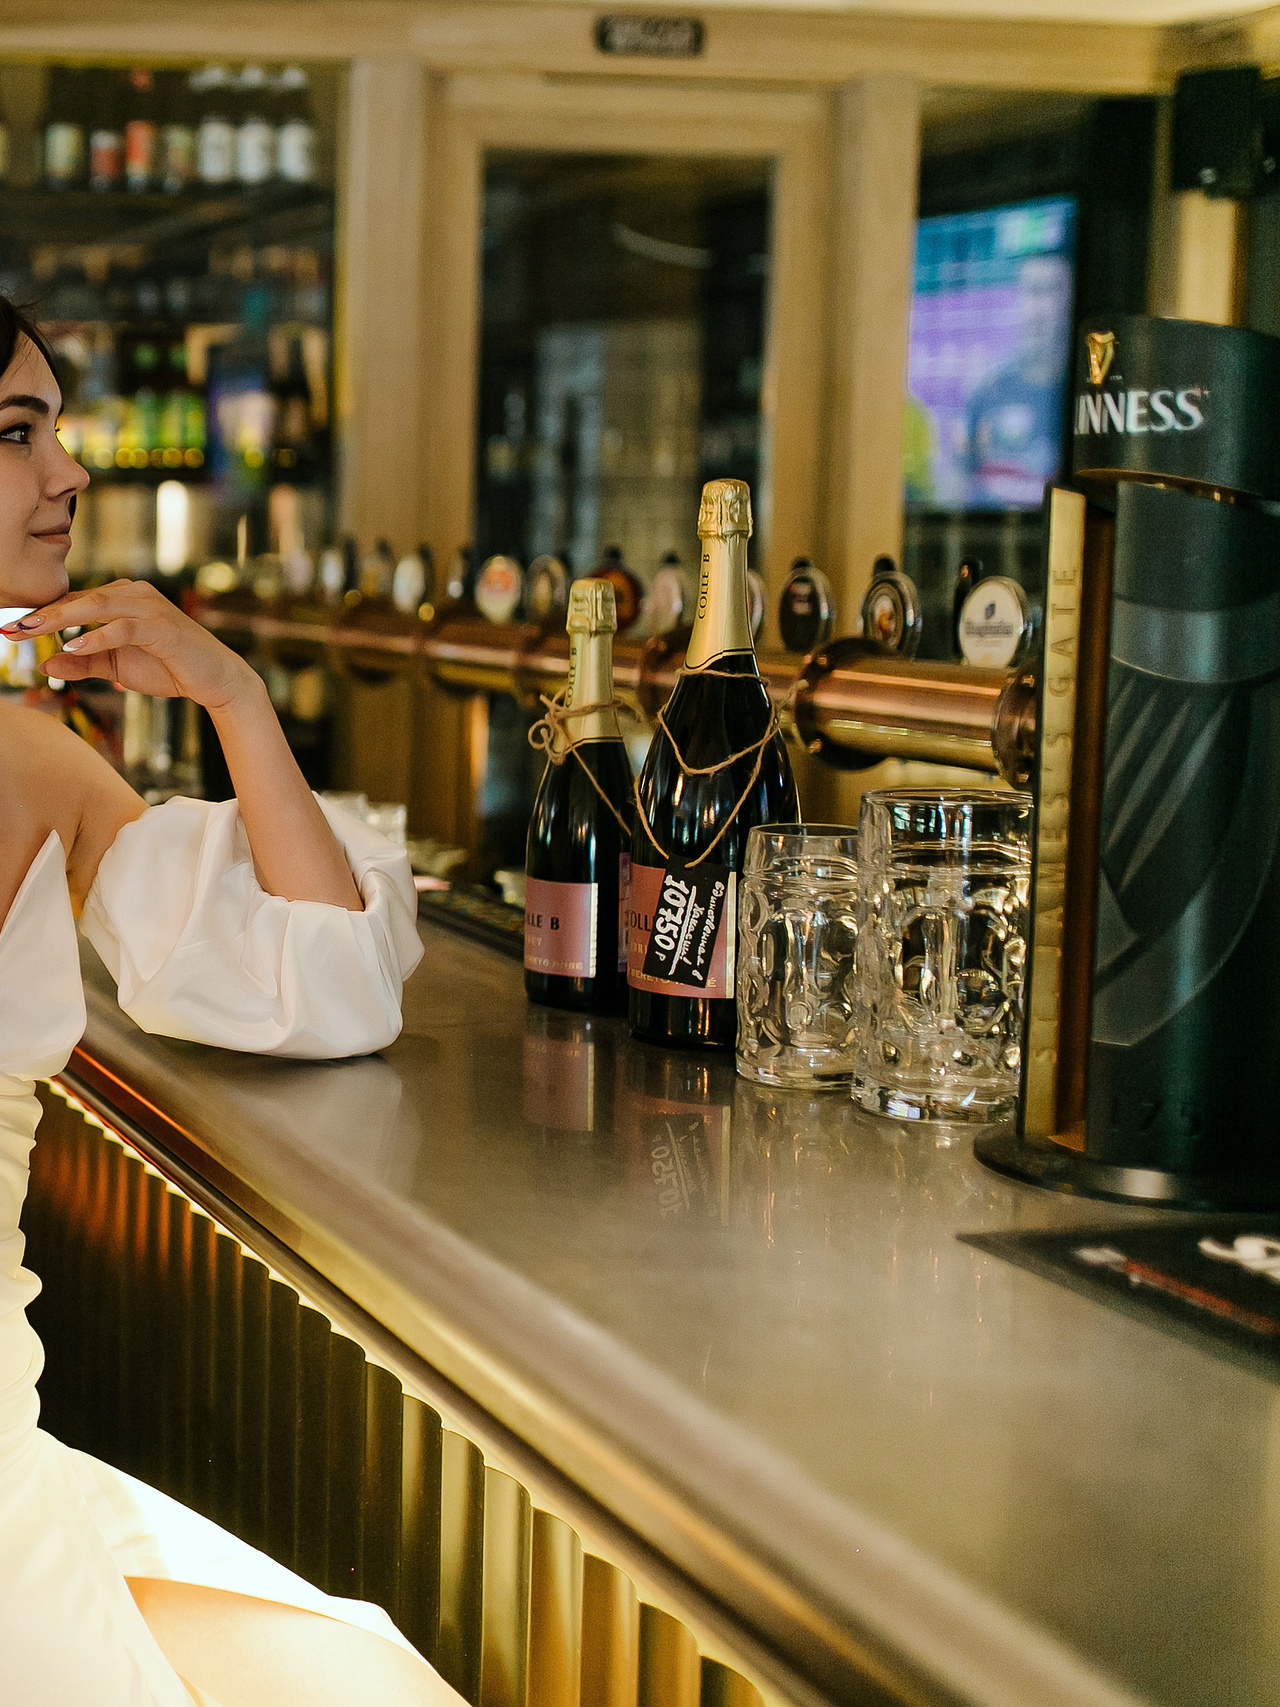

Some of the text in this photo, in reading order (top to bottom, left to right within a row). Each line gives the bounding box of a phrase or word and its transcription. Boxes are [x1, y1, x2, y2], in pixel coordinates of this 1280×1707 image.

[1074, 389, 1204, 435] INNESS
[698, 553, 711, 620] COLLE B
[1048, 568, 1078, 697] GATE
[526, 913, 561, 931] LLE B
[654, 874, 690, 951] 10750
